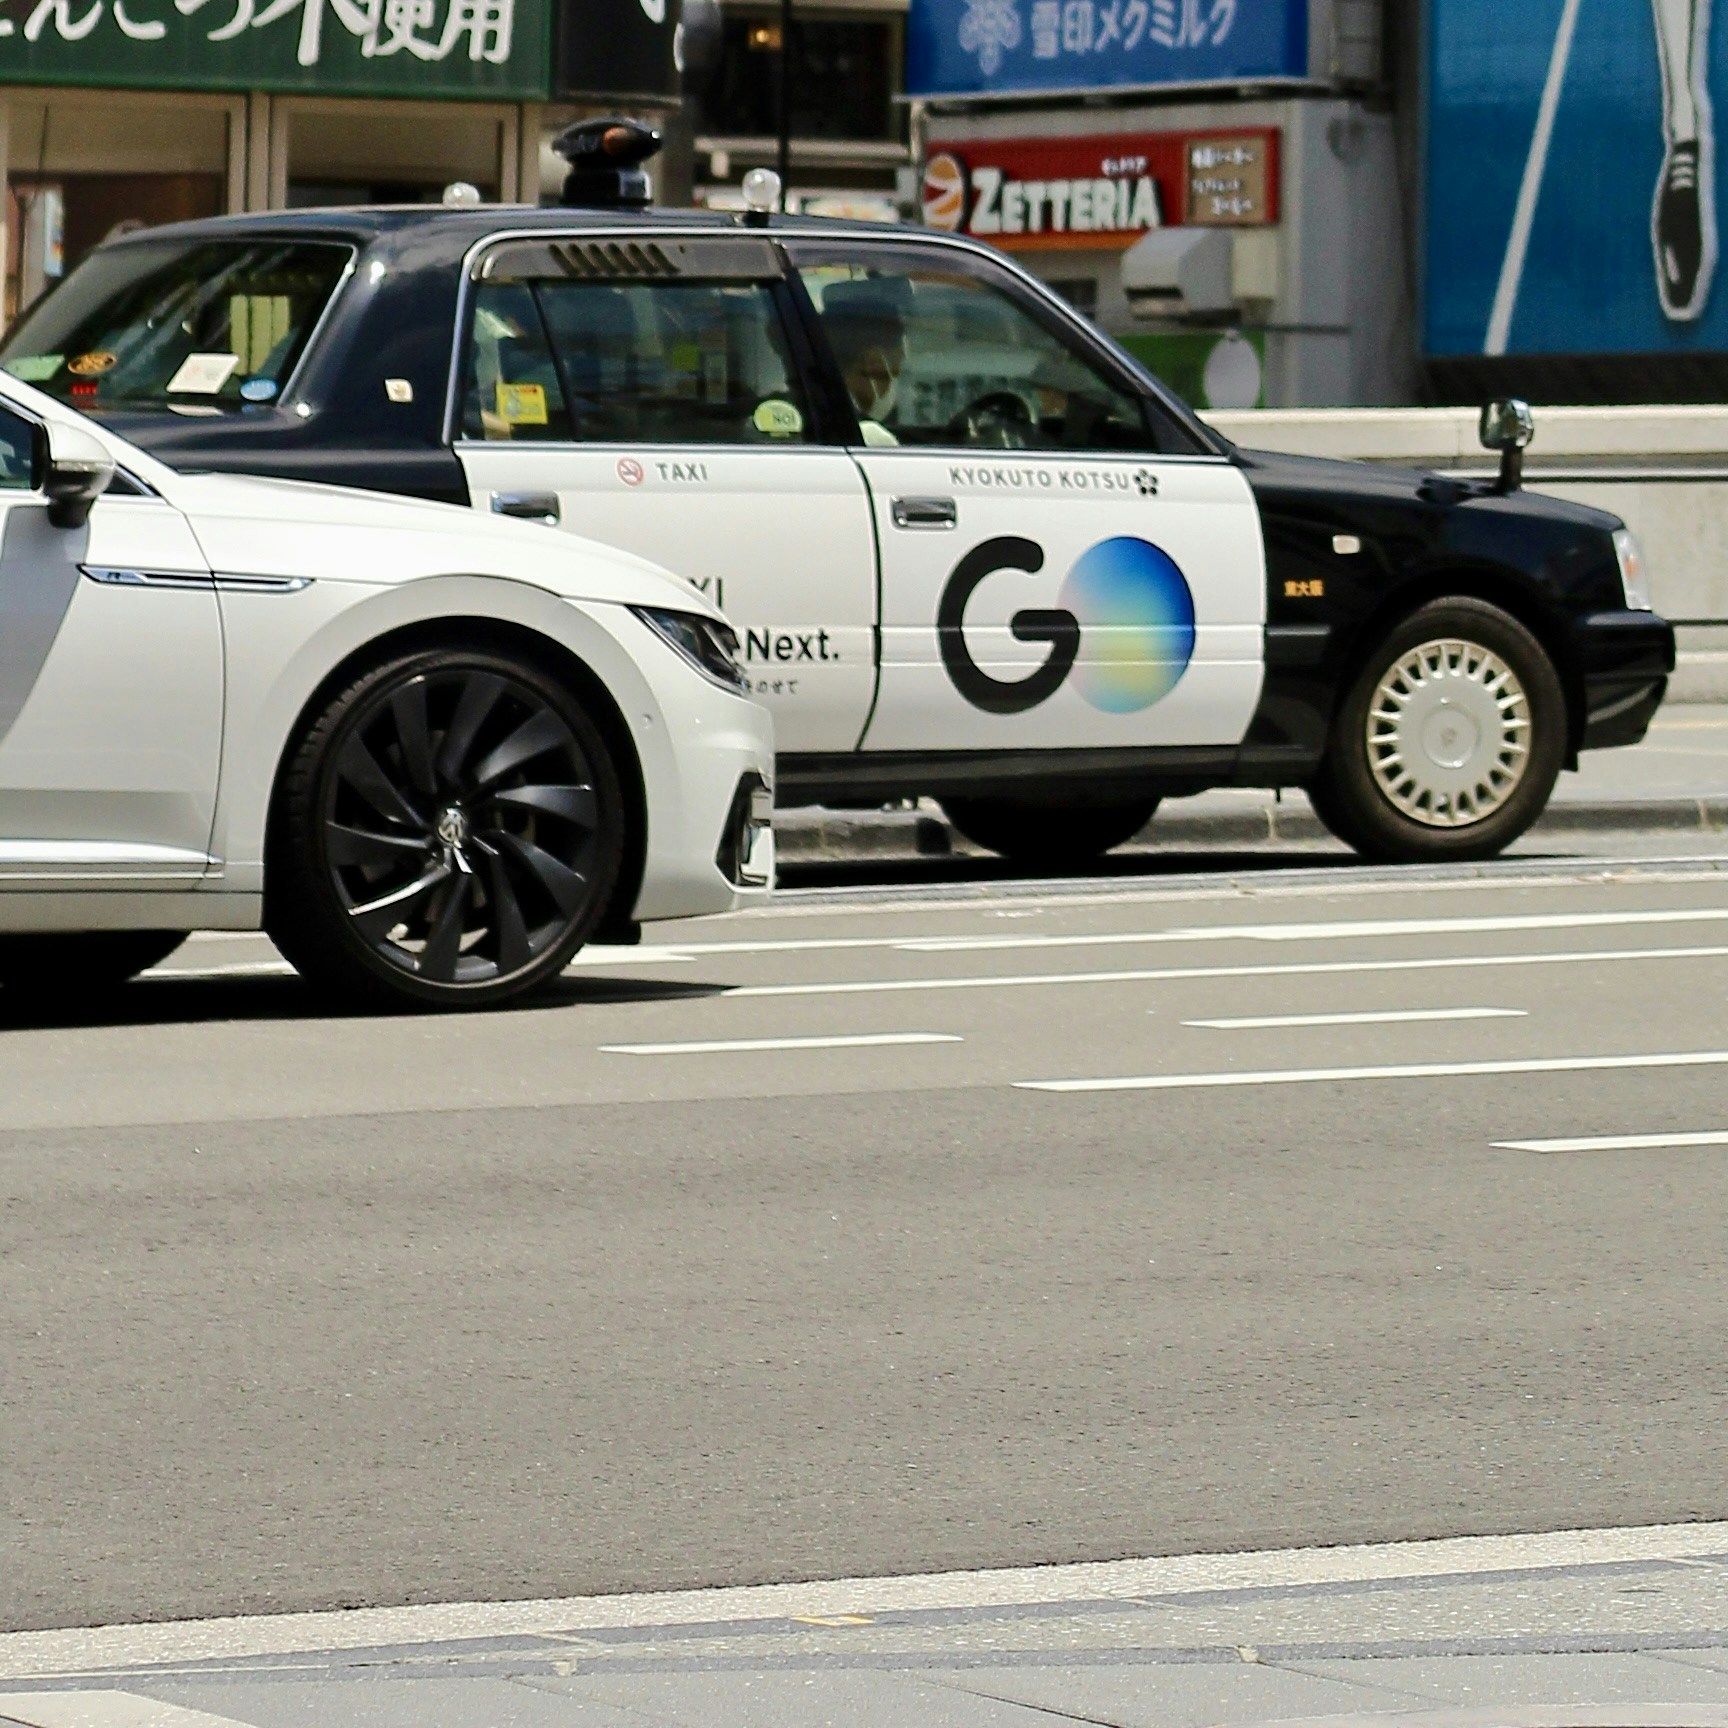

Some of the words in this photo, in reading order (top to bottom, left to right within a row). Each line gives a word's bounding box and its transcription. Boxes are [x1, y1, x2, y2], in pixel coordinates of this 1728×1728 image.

[969, 167, 1163, 234] ZETTERIA
[656, 462, 708, 482] TAXI
[948, 466, 1052, 489] KYOKUTO
[1058, 470, 1130, 492] KOTSU
[746, 627, 839, 661] Next.
